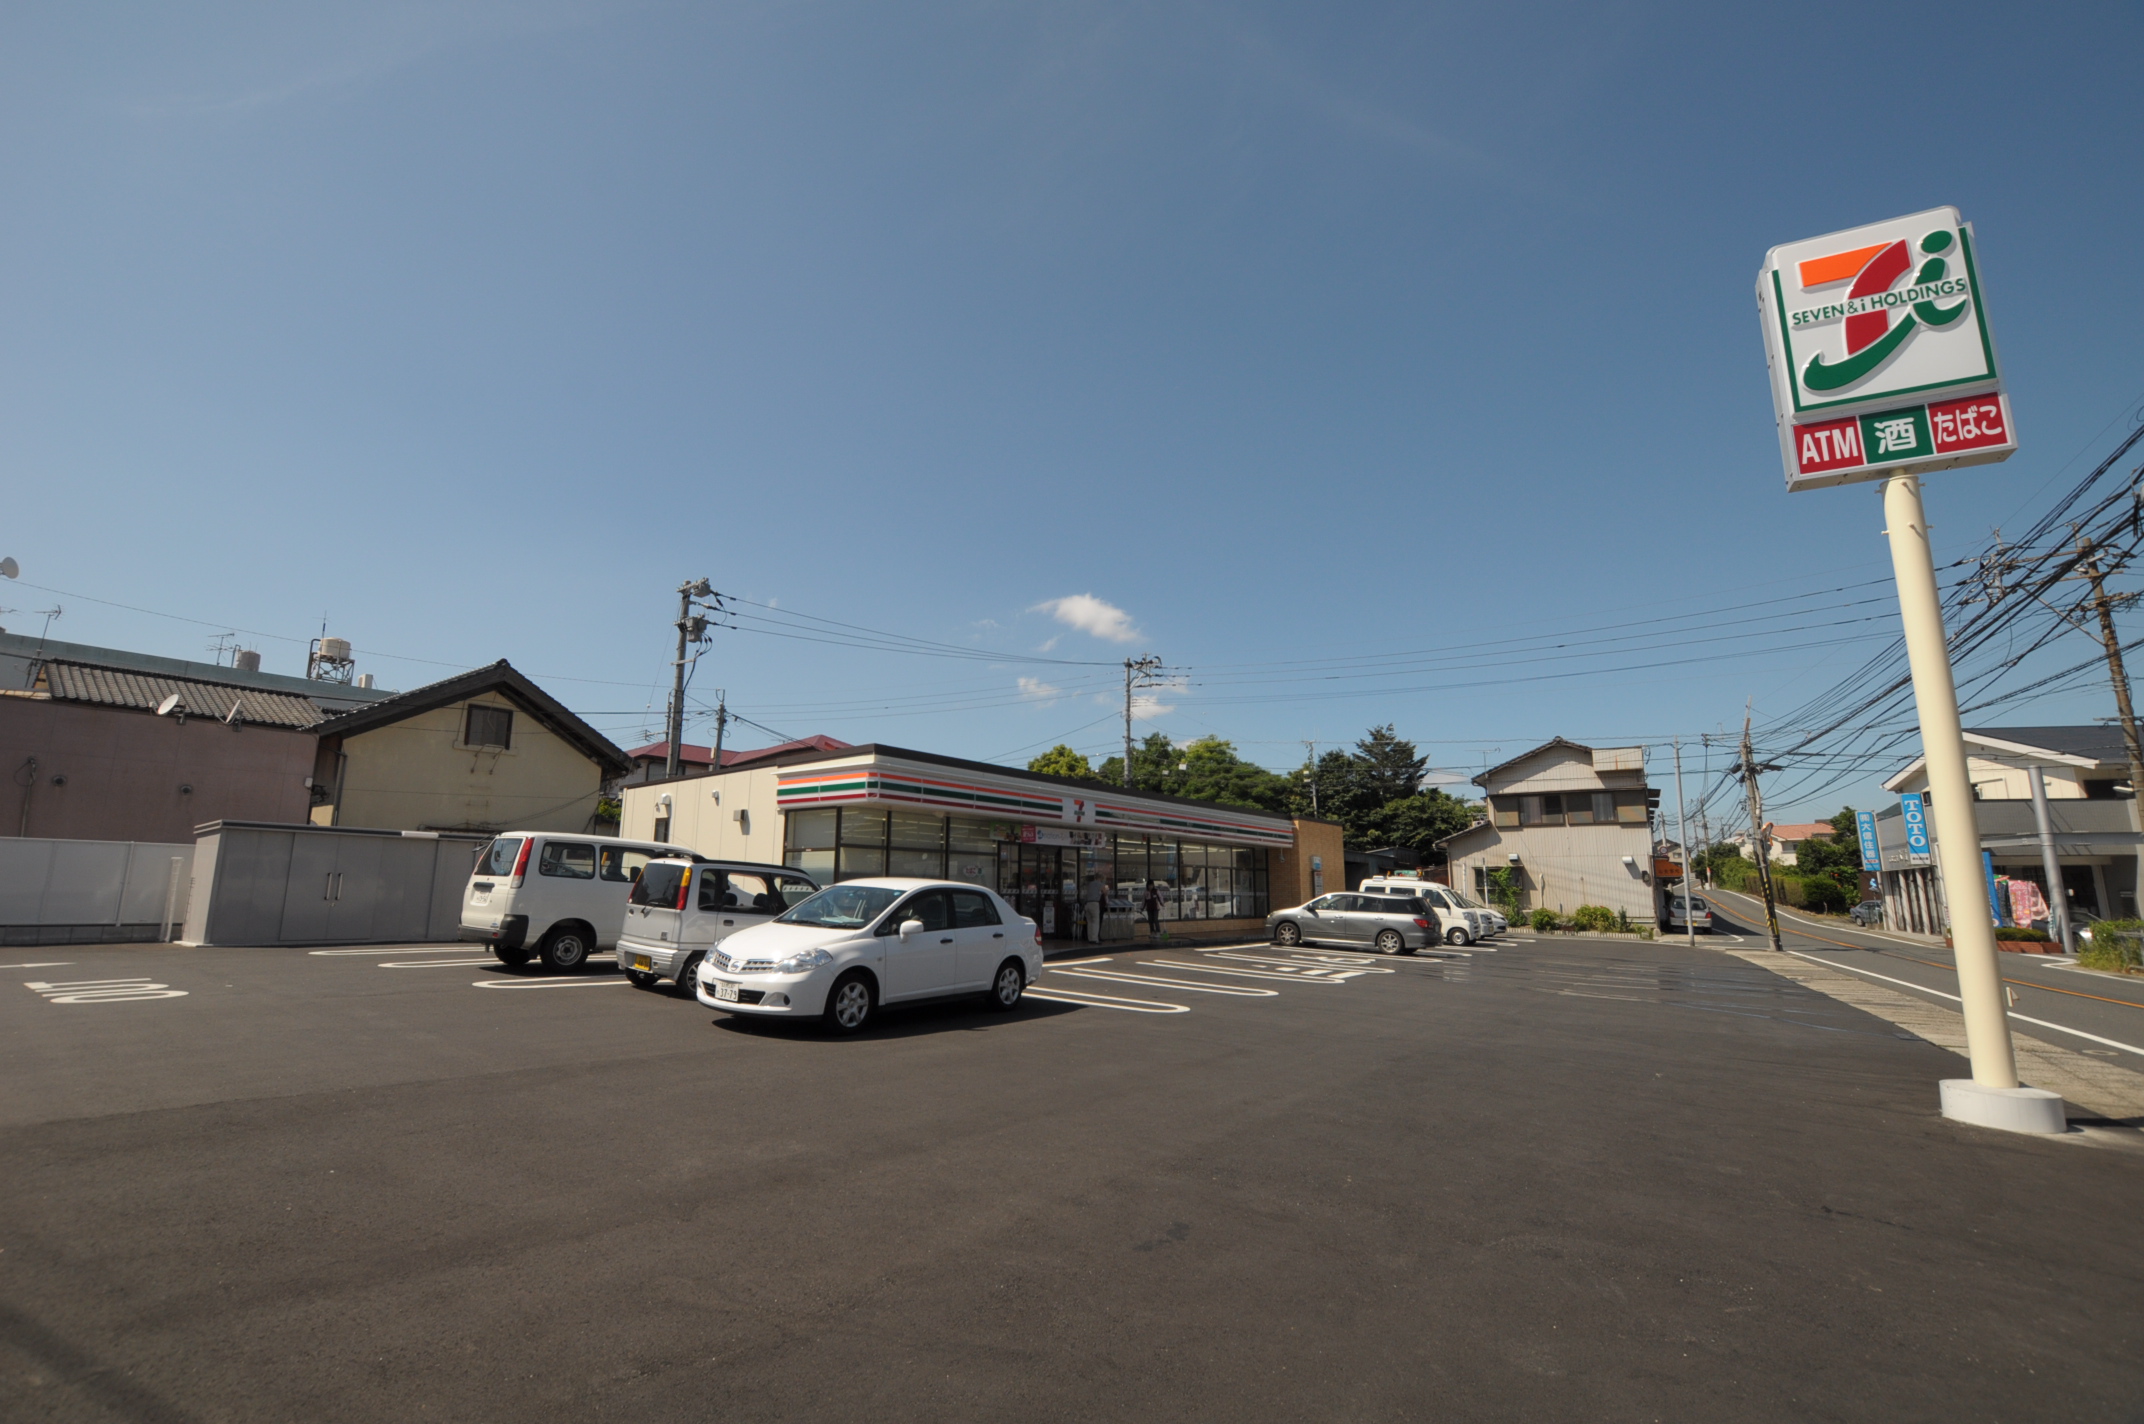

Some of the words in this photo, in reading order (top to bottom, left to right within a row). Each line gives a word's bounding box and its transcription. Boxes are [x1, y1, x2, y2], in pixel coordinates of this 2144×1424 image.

[1871, 278, 1966, 309] HOLDINGS
[1873, 417, 1917, 454] 酒
[1933, 405, 2003, 444] たばこ
[1801, 426, 1859, 464] ATM
[1904, 799, 1926, 847] TOTO
